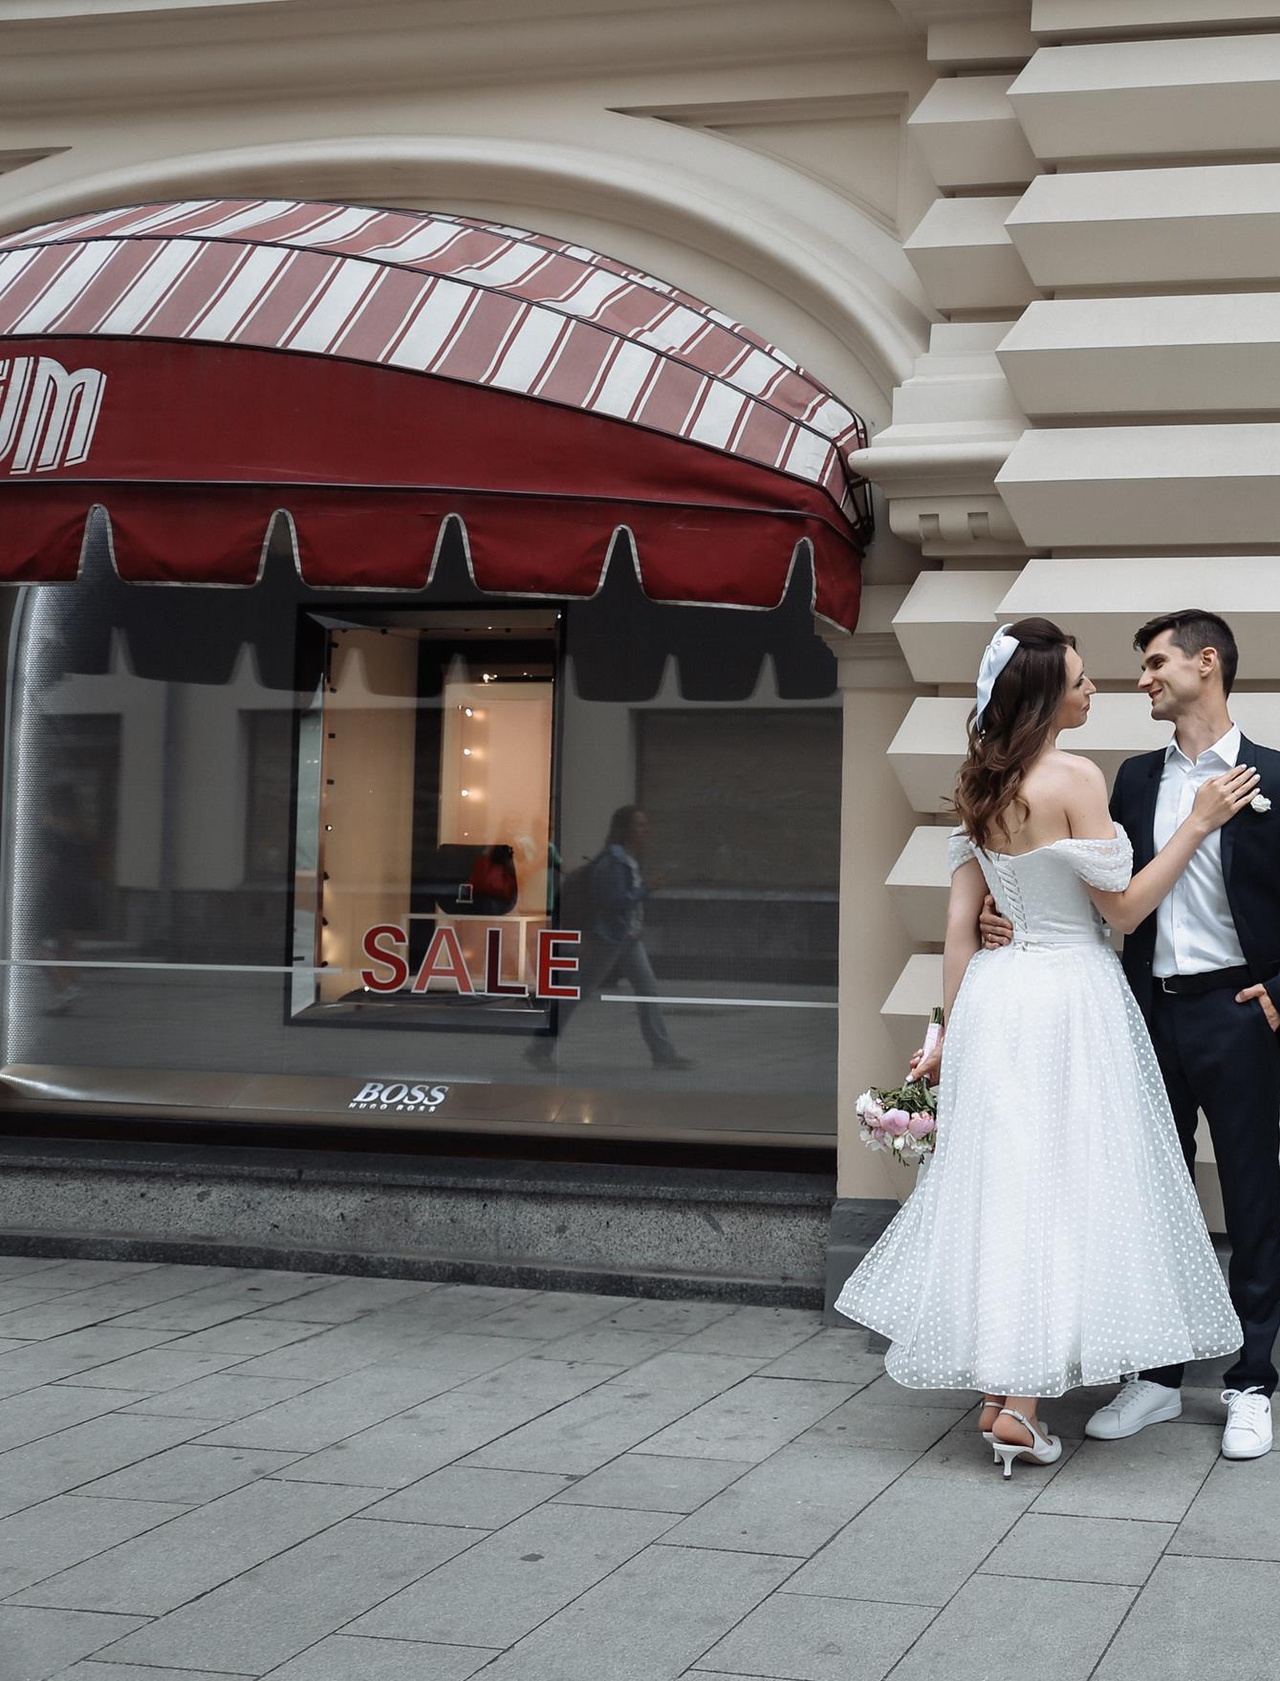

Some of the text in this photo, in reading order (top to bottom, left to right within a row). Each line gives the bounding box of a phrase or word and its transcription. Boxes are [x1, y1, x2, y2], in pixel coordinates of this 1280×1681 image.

[360, 923, 582, 1000] SALE
[352, 1082, 450, 1106] BOSS
[348, 1102, 388, 1111] HUGO
